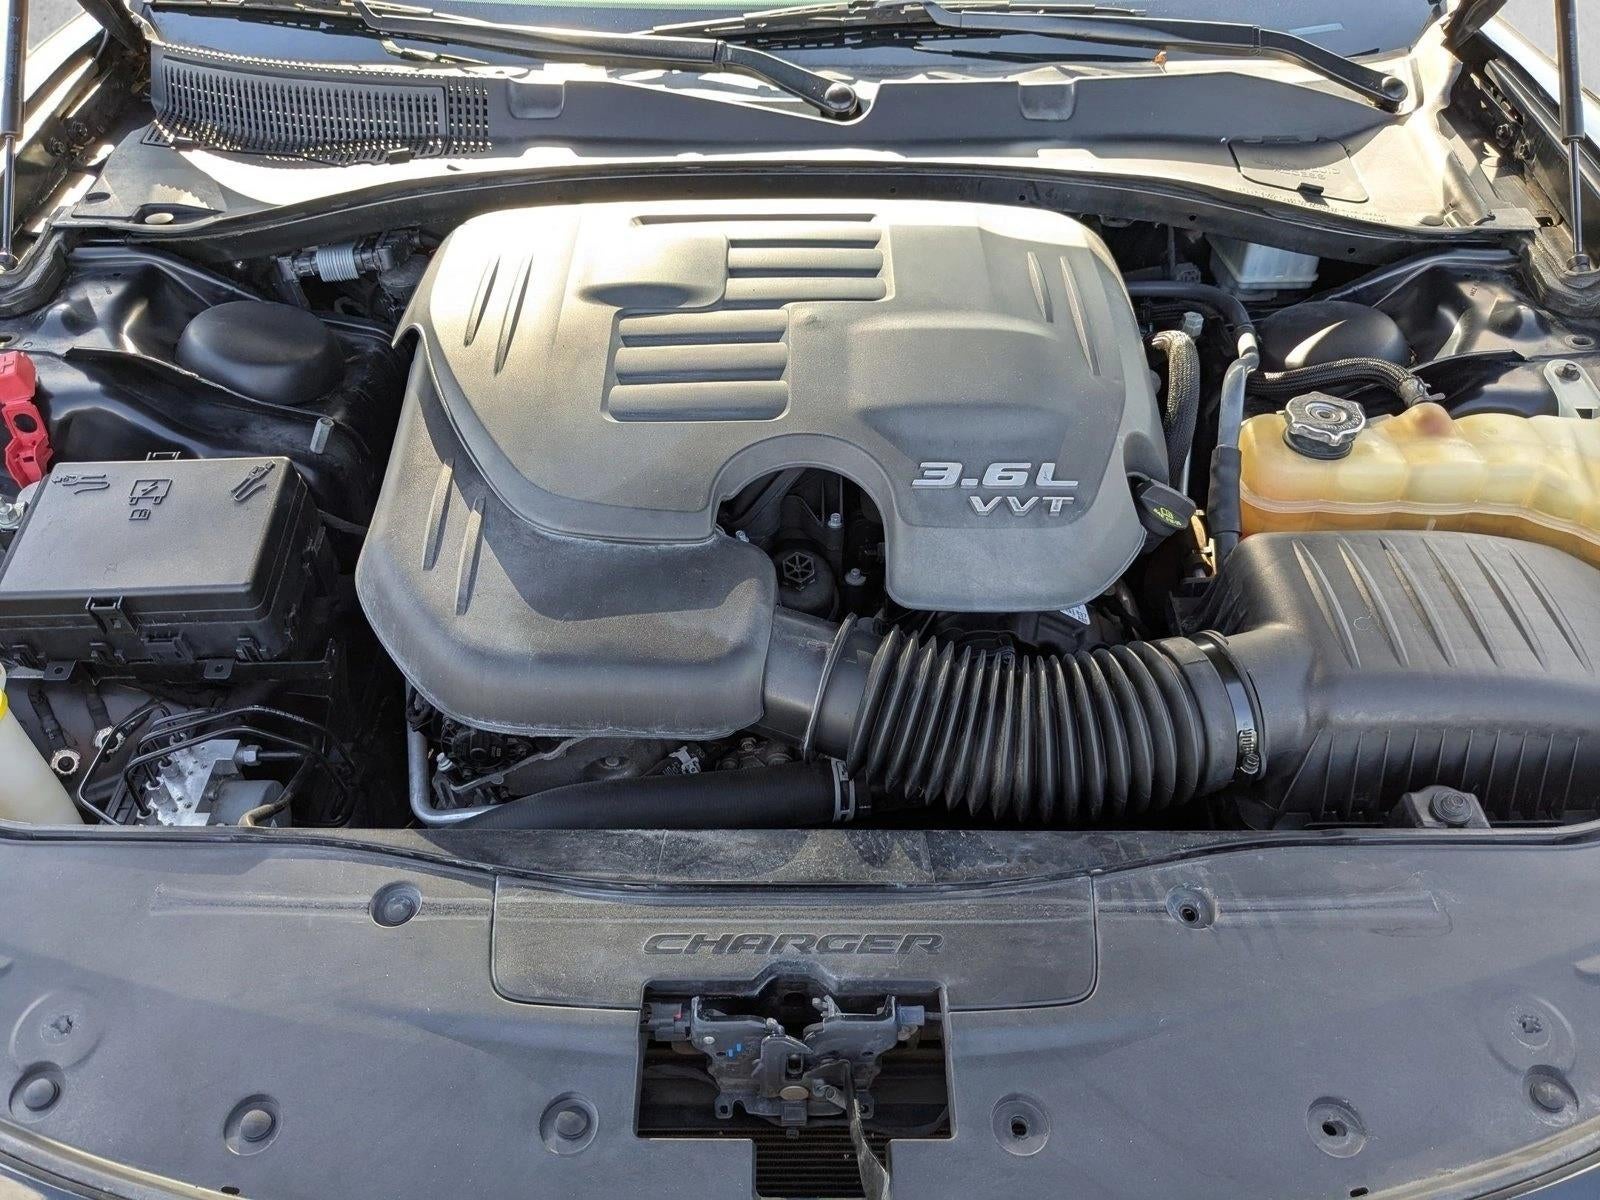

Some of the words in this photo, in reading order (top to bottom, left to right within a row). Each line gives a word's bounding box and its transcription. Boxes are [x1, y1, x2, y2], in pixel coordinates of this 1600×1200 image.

[911, 462, 1079, 488] 3.6L
[969, 495, 1075, 517] VVT
[643, 932, 945, 955] CHARGER
